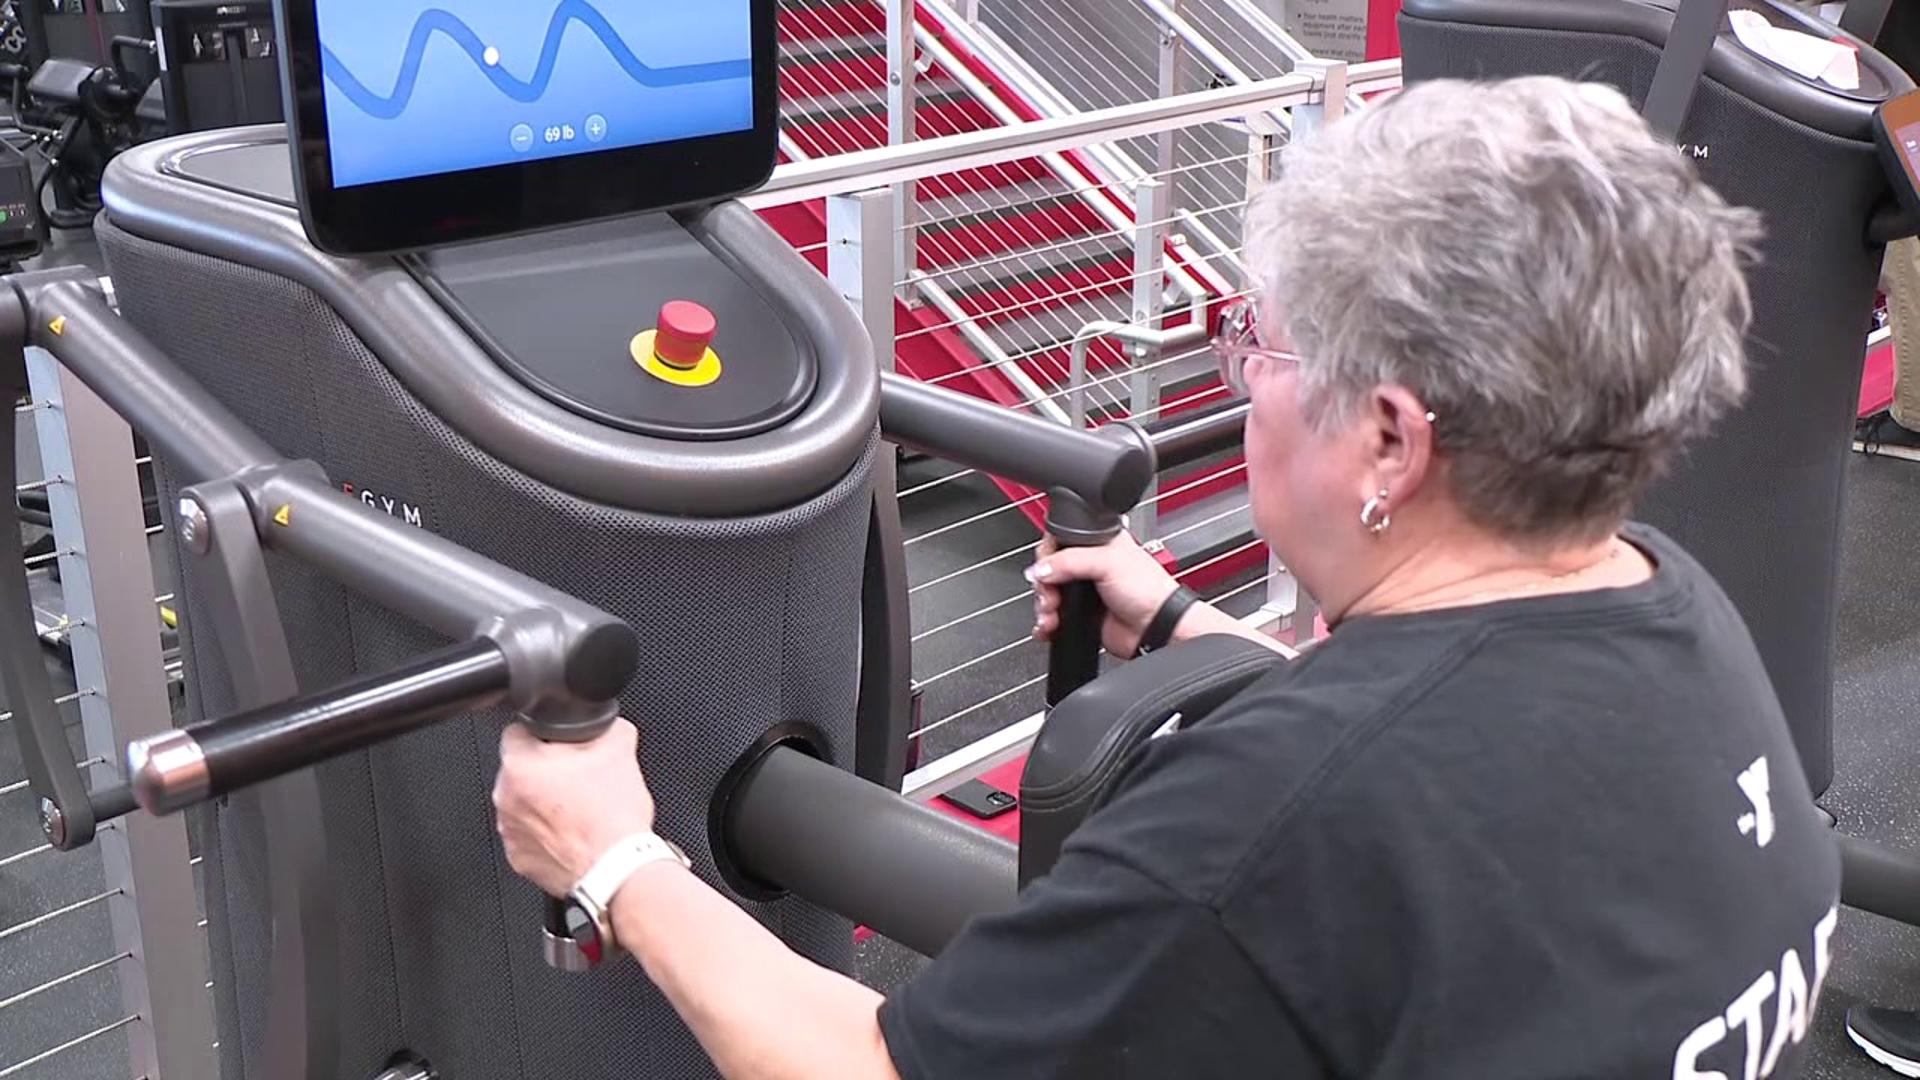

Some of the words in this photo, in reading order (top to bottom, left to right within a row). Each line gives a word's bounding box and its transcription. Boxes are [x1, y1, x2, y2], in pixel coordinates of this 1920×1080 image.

[544, 126, 561, 143] 69
[562, 124, 575, 140] lb
[1676, 143, 1708, 158] YM
